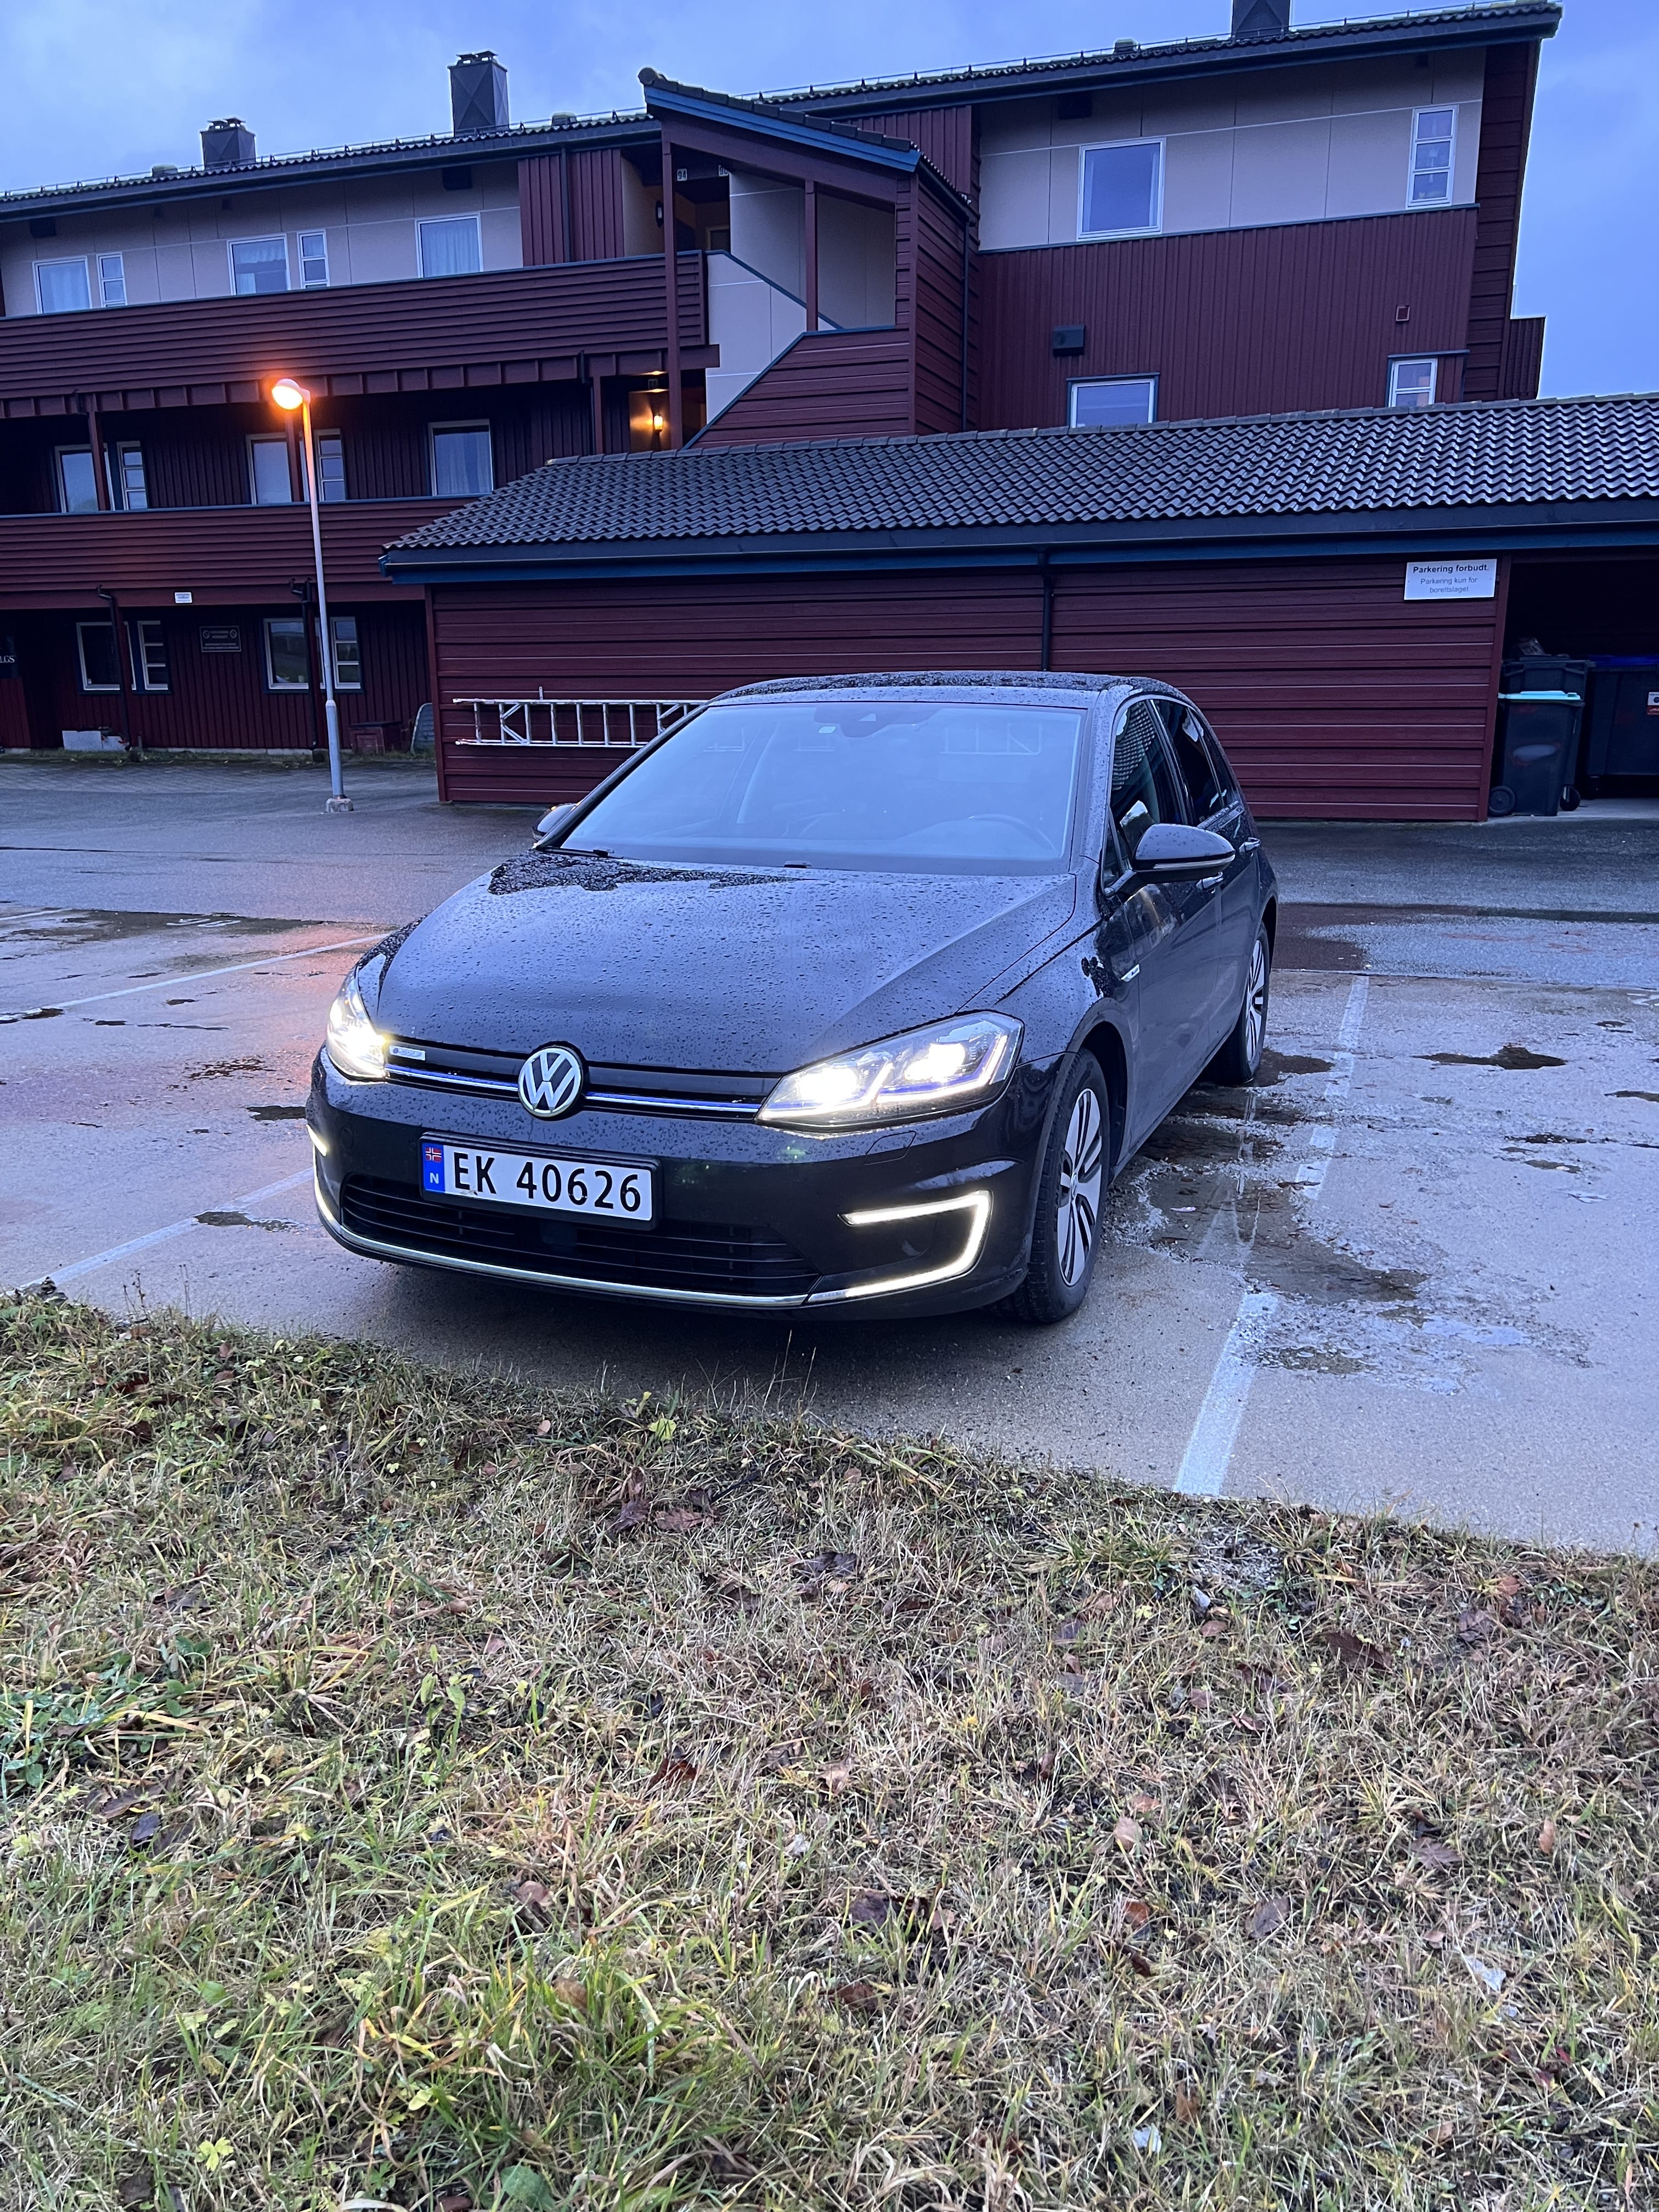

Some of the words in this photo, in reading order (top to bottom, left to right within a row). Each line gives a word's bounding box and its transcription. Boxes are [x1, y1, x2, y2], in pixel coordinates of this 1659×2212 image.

[678, 171, 686, 179] 94
[518, 1048, 581, 1114] VW
[430, 1172, 439, 1184] N
[454, 1152, 497, 1194] EK
[516, 1161, 641, 1212] 40626
